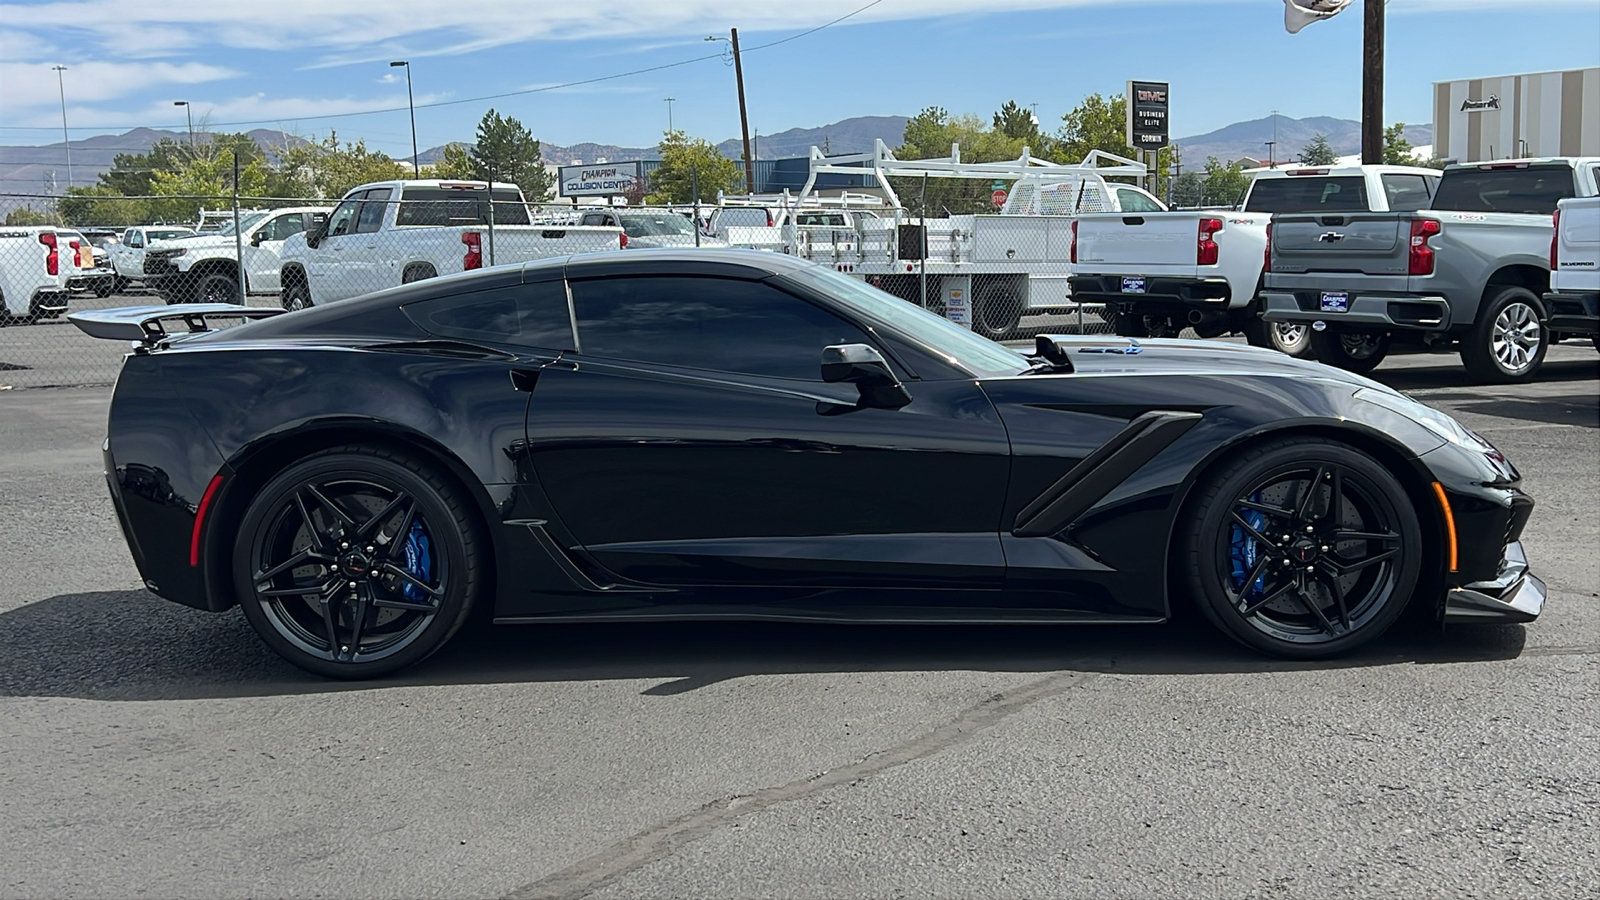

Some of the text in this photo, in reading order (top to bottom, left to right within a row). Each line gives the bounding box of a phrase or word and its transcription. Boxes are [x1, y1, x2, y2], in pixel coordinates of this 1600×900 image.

[1138, 90, 1166, 102] GMC
[582, 169, 616, 181] CHAMPION
[567, 181, 602, 191] COLLISION
[992, 195, 1007, 203] STOP
